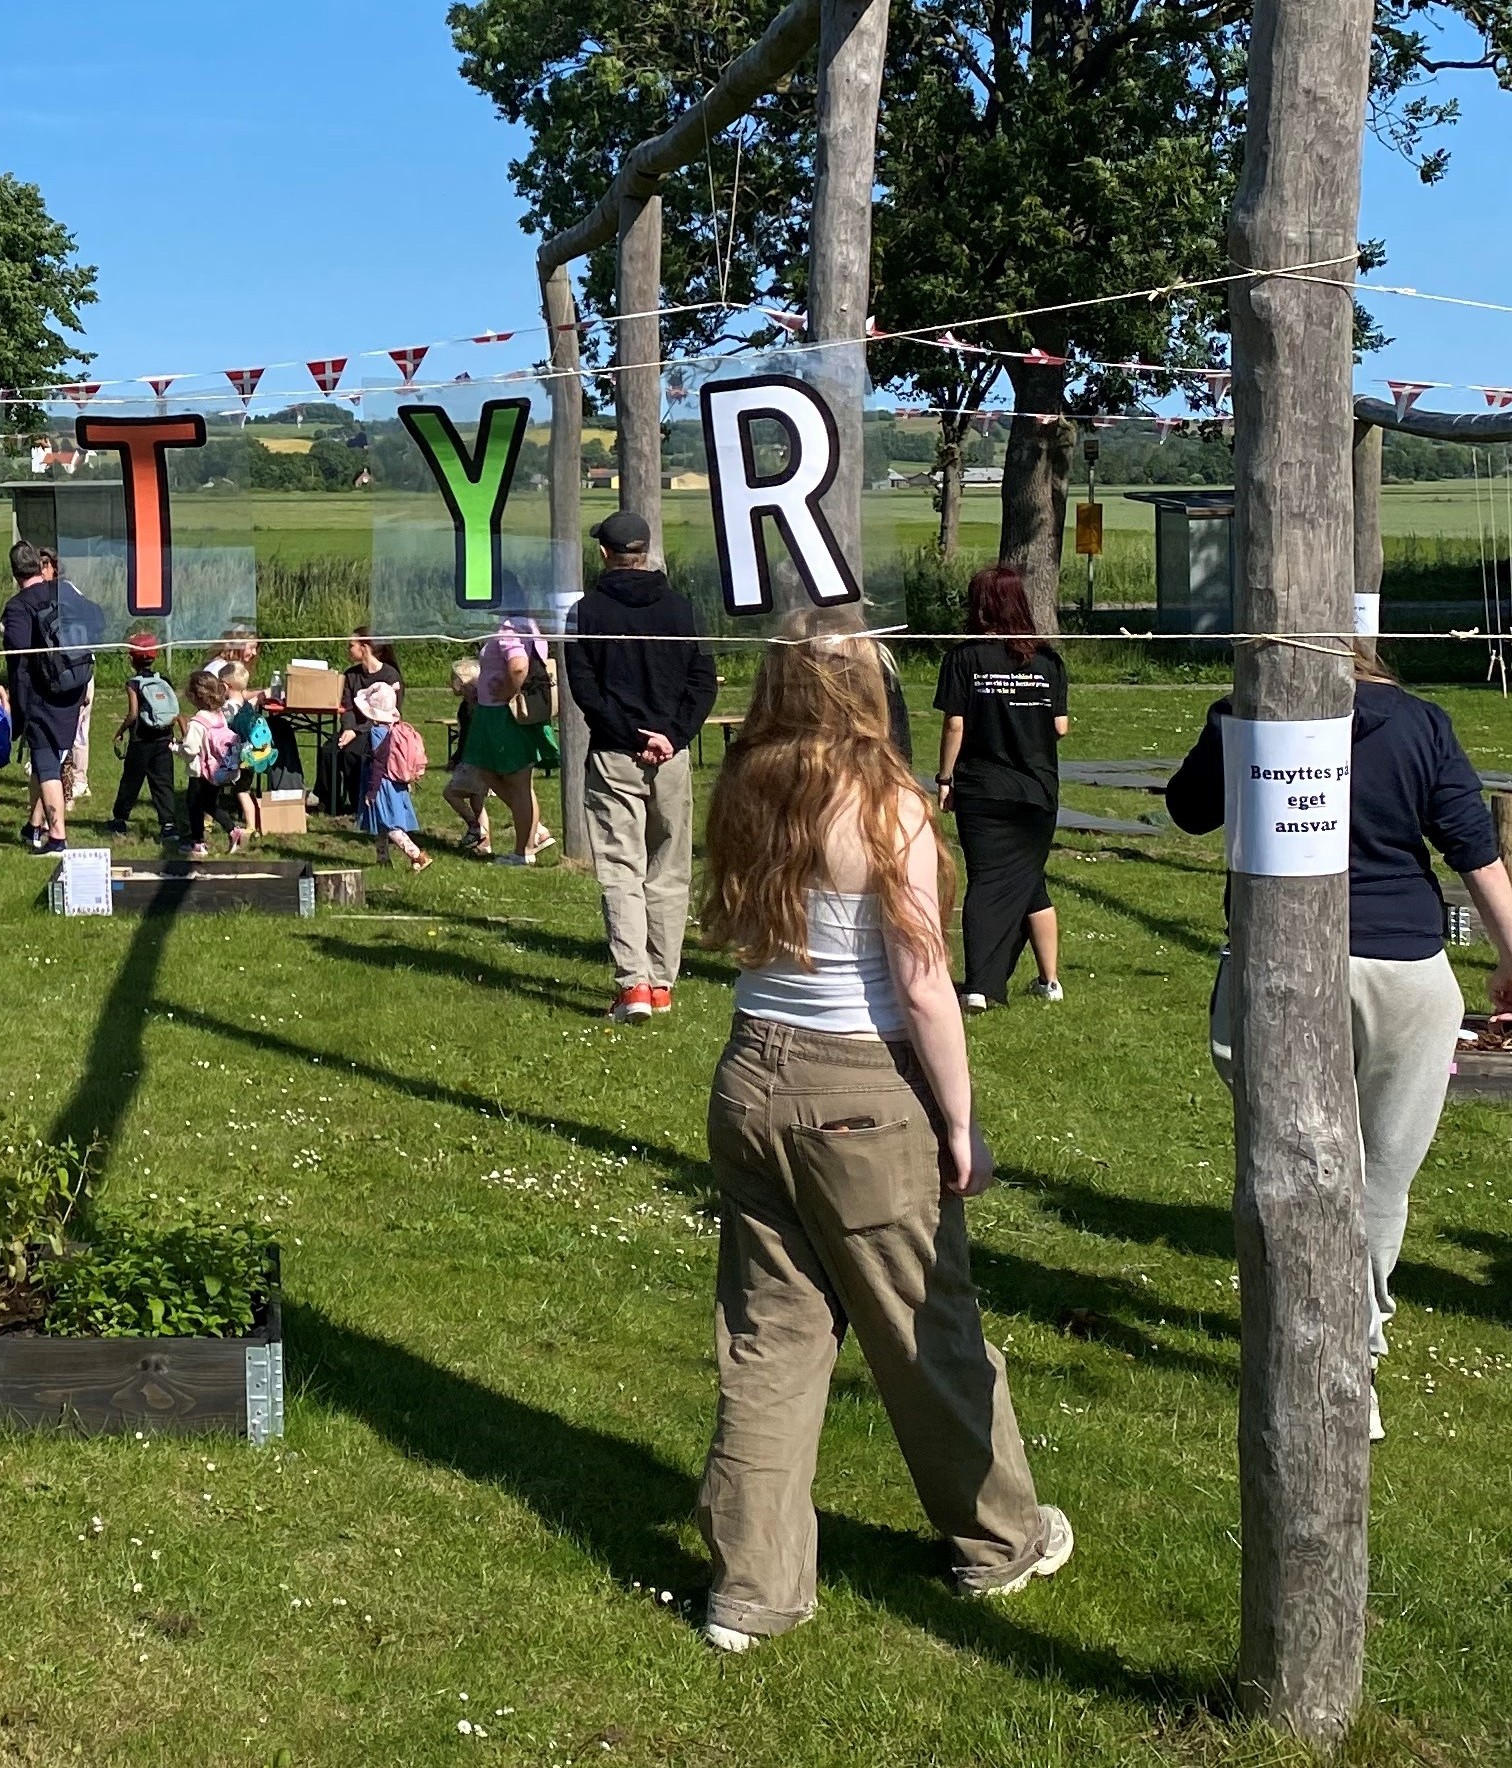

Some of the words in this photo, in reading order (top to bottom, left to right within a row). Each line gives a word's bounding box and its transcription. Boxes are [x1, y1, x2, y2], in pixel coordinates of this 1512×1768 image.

[1250, 765, 1332, 784] Benyttes
[1287, 792, 1326, 810] eget
[1275, 820, 1338, 833] ansvar
